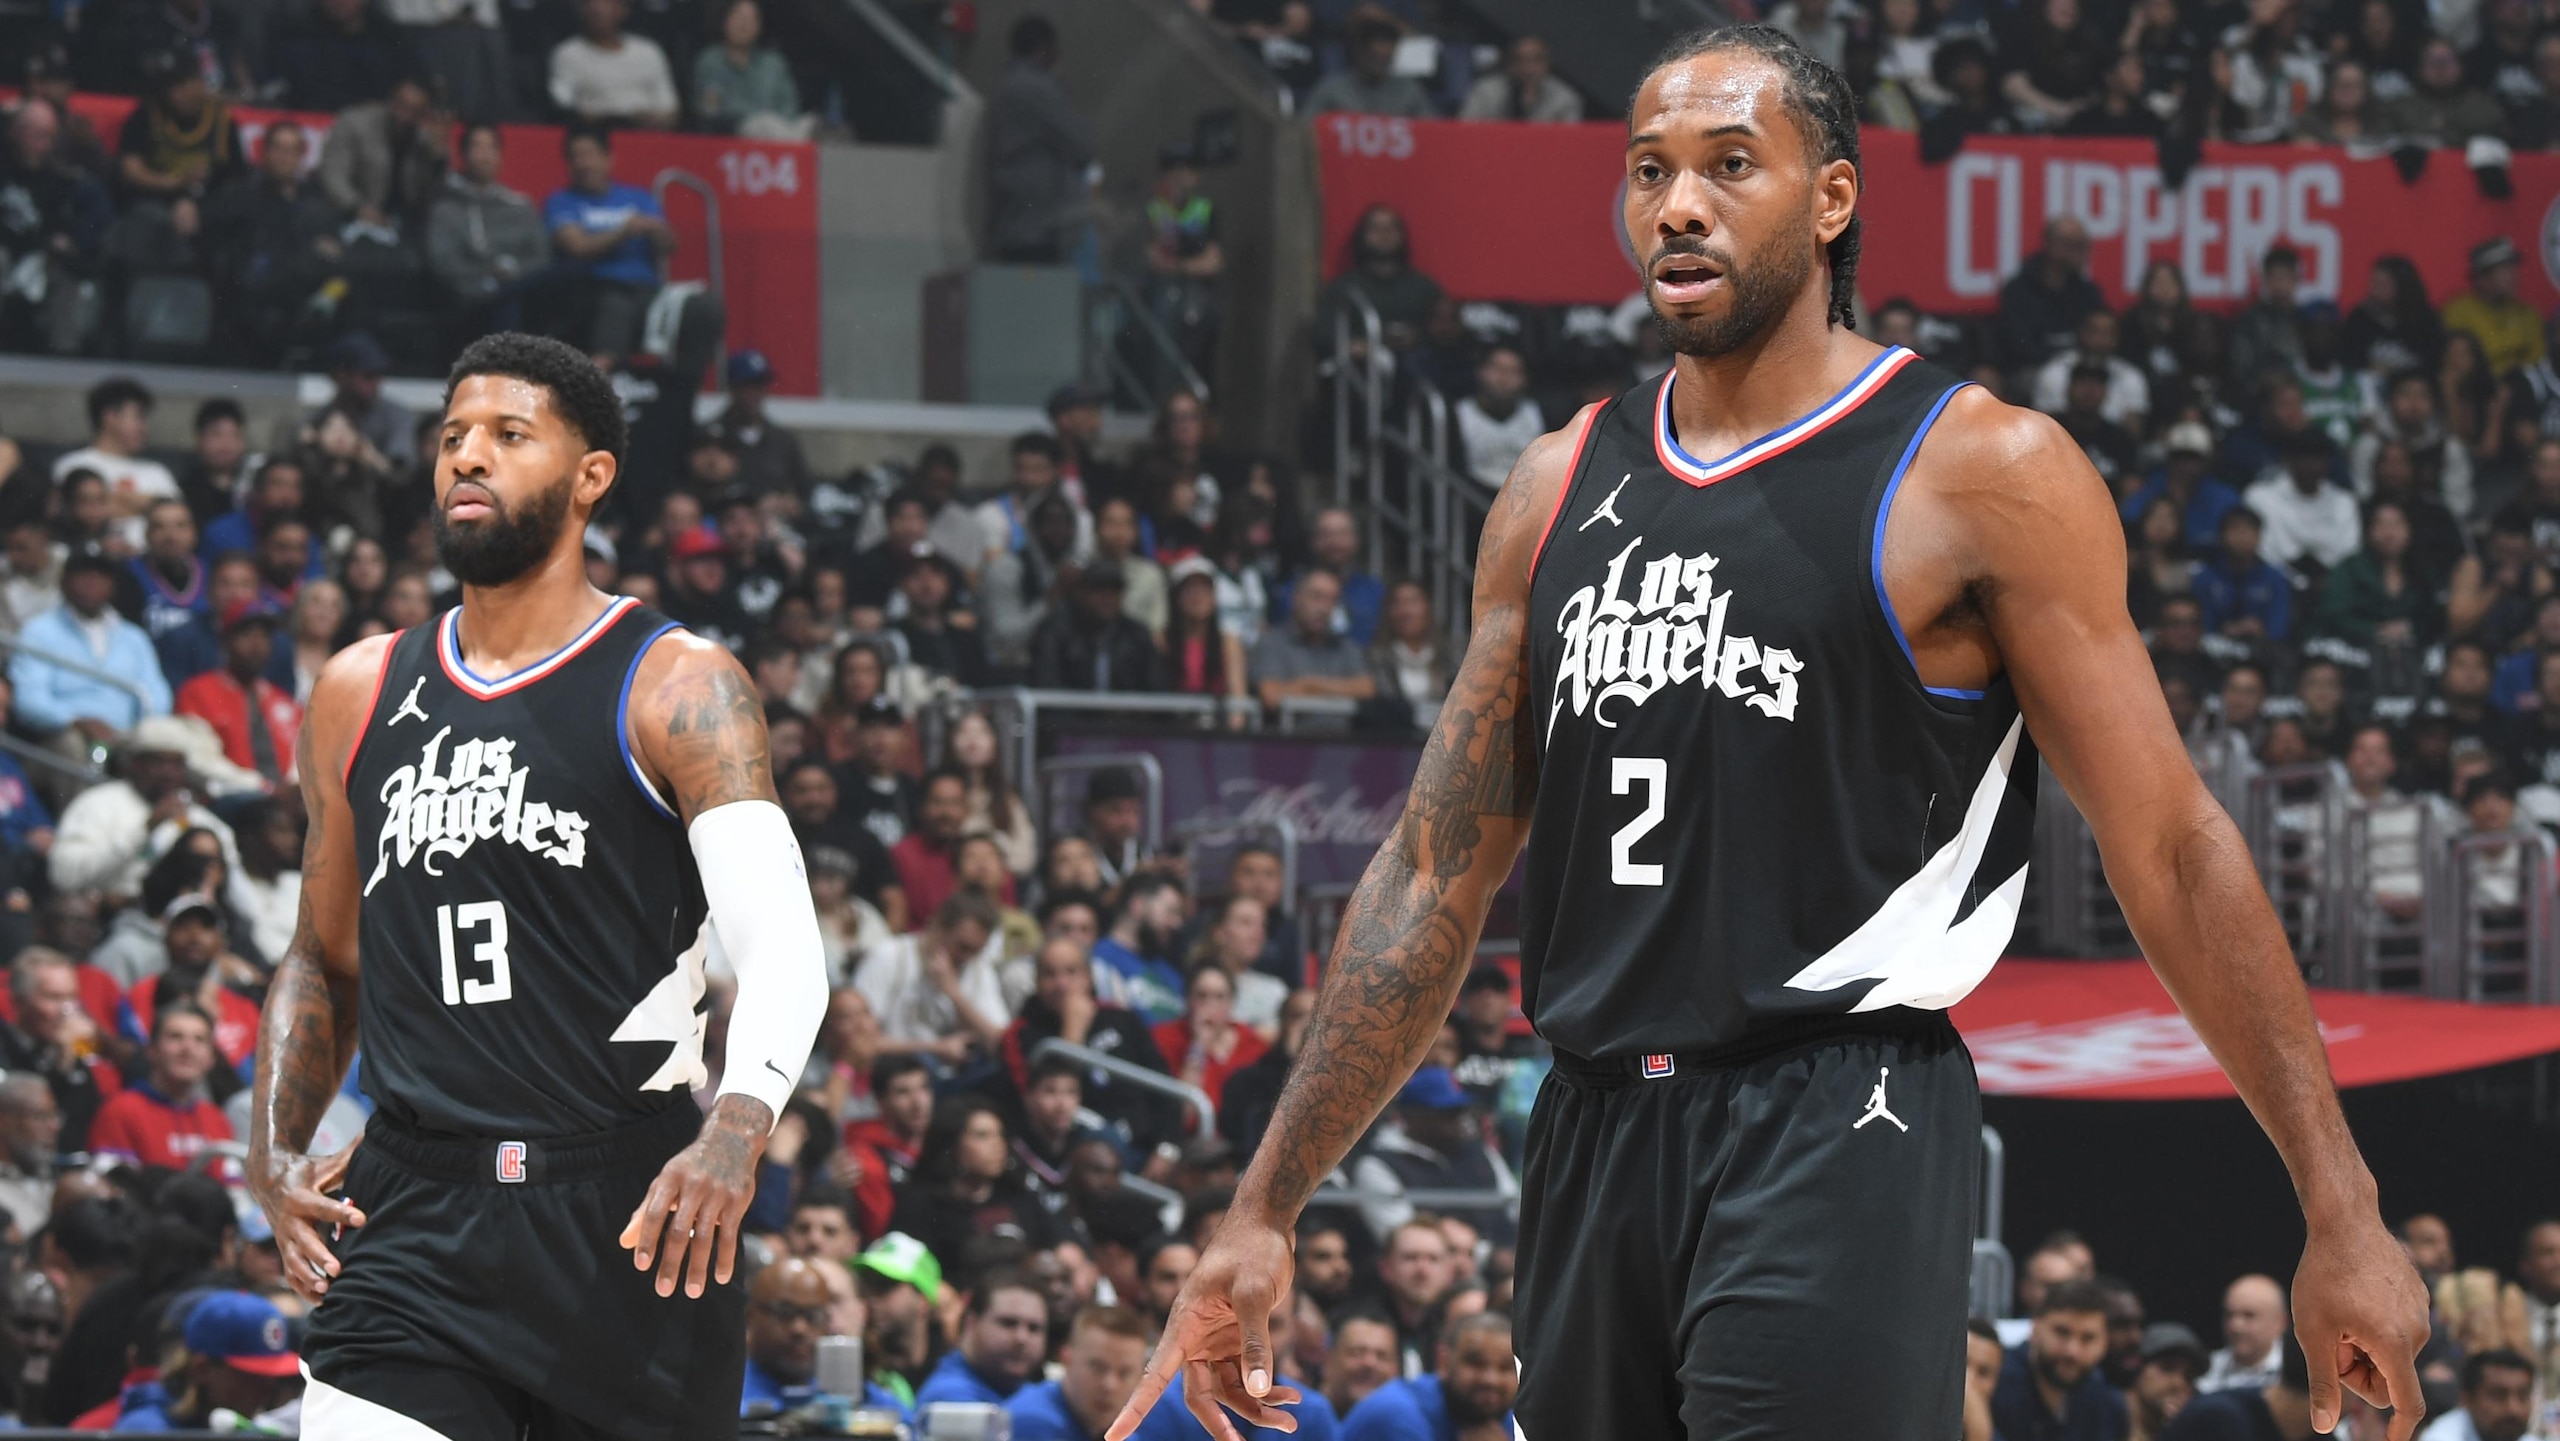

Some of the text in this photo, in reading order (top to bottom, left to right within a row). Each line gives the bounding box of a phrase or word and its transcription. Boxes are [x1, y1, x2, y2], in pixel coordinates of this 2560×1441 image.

[719, 150, 799, 196] 104
[1331, 117, 1415, 159] 105
[1590, 536, 1720, 625] Los
[1545, 586, 1805, 753] Angeles
[412, 725, 516, 798] Los
[363, 765, 590, 897] Angeles
[1611, 757, 1667, 886] 2
[437, 900, 512, 1005] 13
